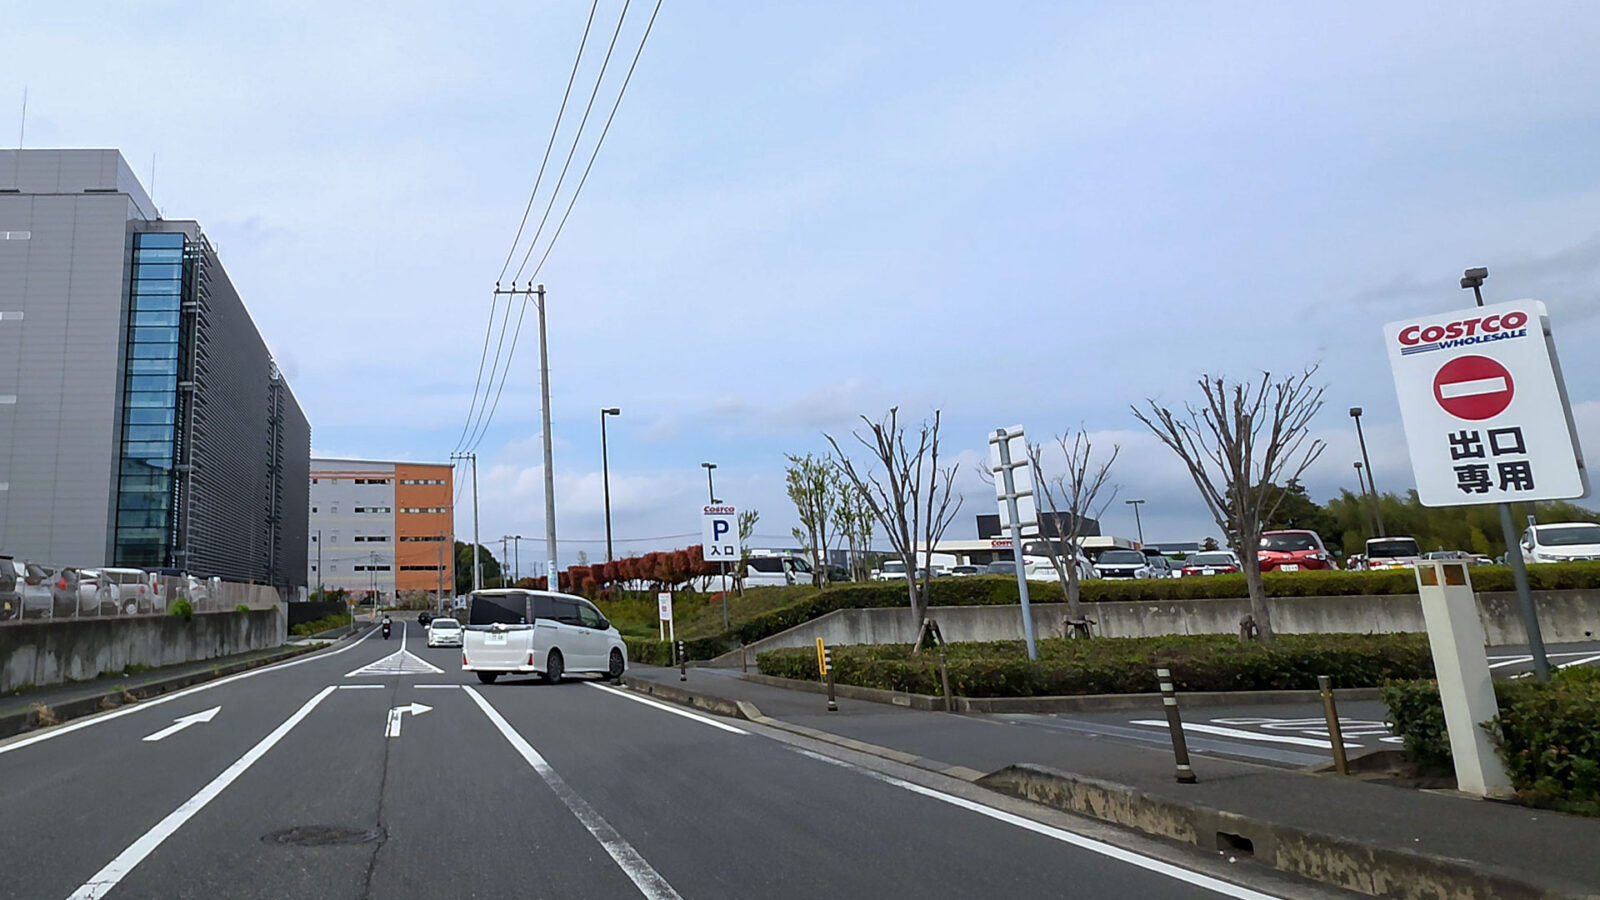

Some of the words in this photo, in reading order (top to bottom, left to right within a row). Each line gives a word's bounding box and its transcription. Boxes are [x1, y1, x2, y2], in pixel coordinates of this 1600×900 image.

[1399, 312, 1527, 346] COSTCO
[1439, 329, 1526, 349] WHOLESALE
[1448, 427, 1526, 460] 出口
[1453, 461, 1534, 494] 専用
[713, 520, 729, 541] P
[711, 546, 734, 556] 入口
